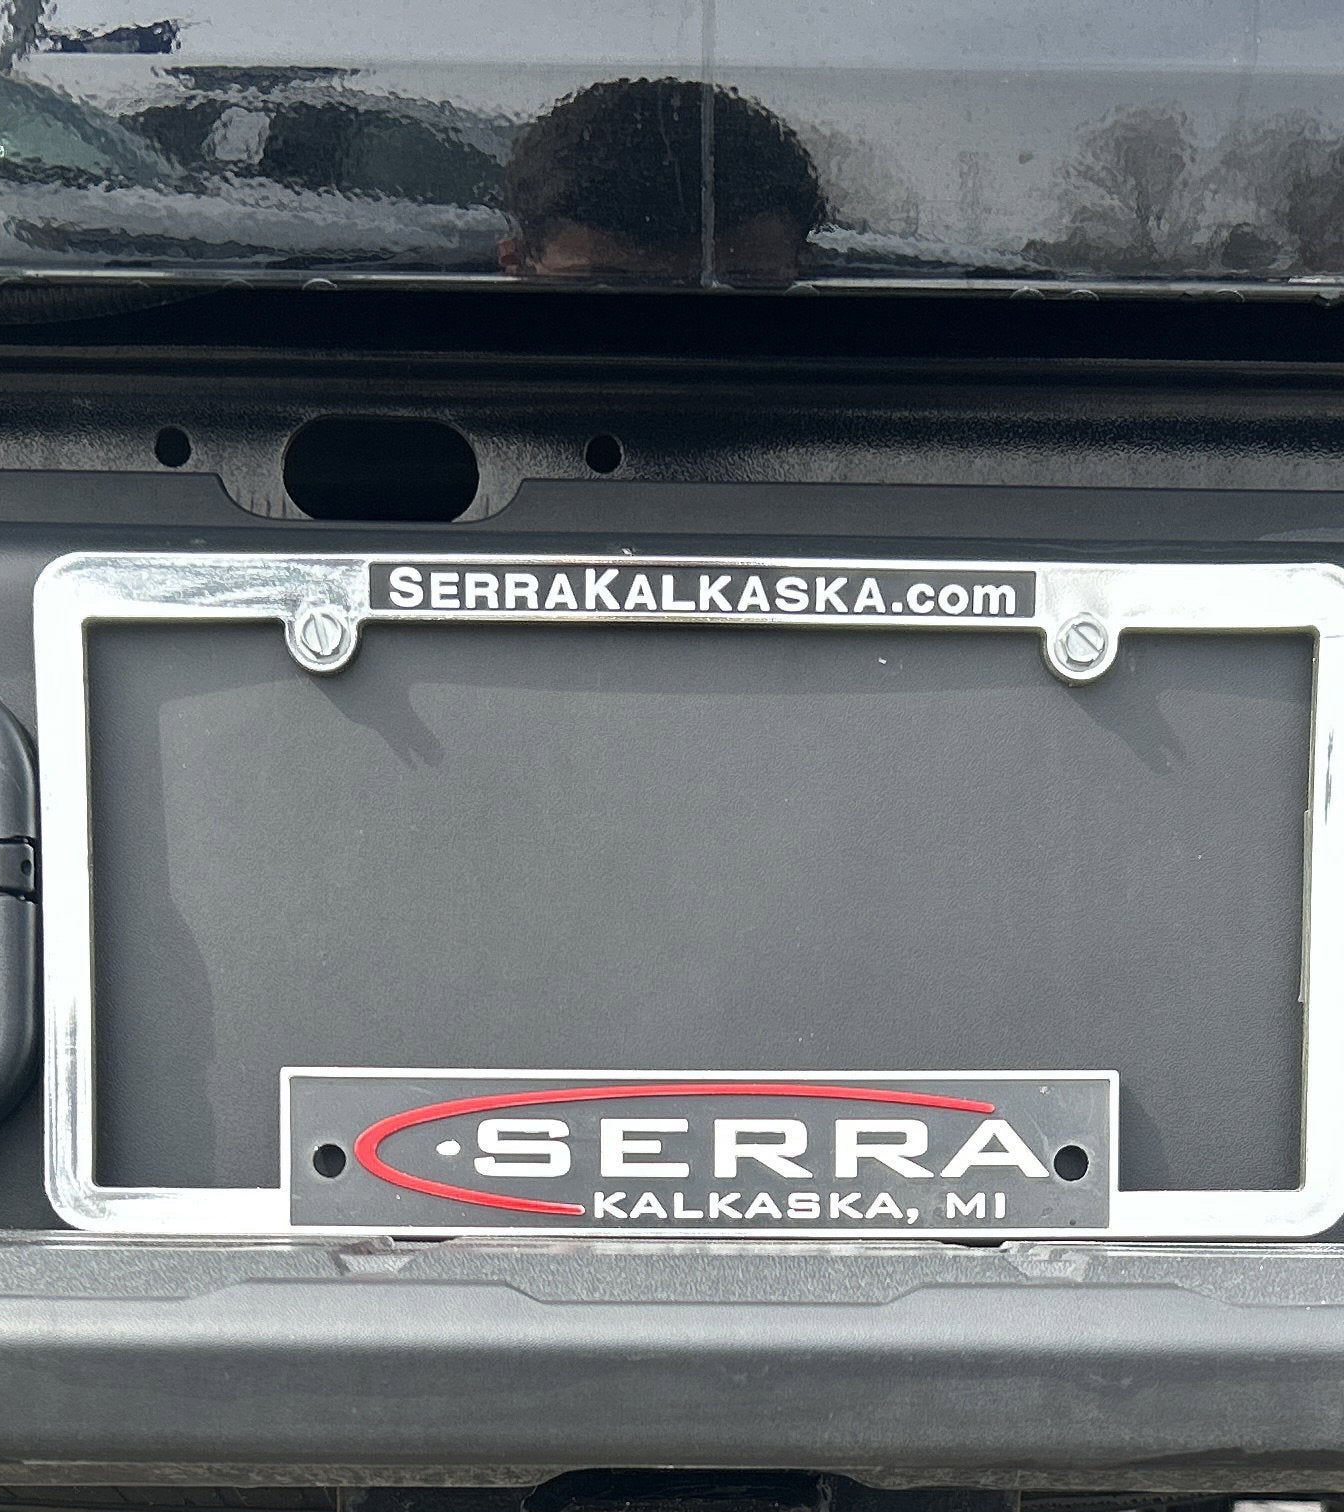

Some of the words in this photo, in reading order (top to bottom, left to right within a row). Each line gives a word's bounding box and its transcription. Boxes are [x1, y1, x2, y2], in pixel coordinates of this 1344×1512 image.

[473, 1116, 1052, 1180] SERRA
[593, 1189, 919, 1225] KALKASKA,
[946, 1192, 1008, 1220] MI
